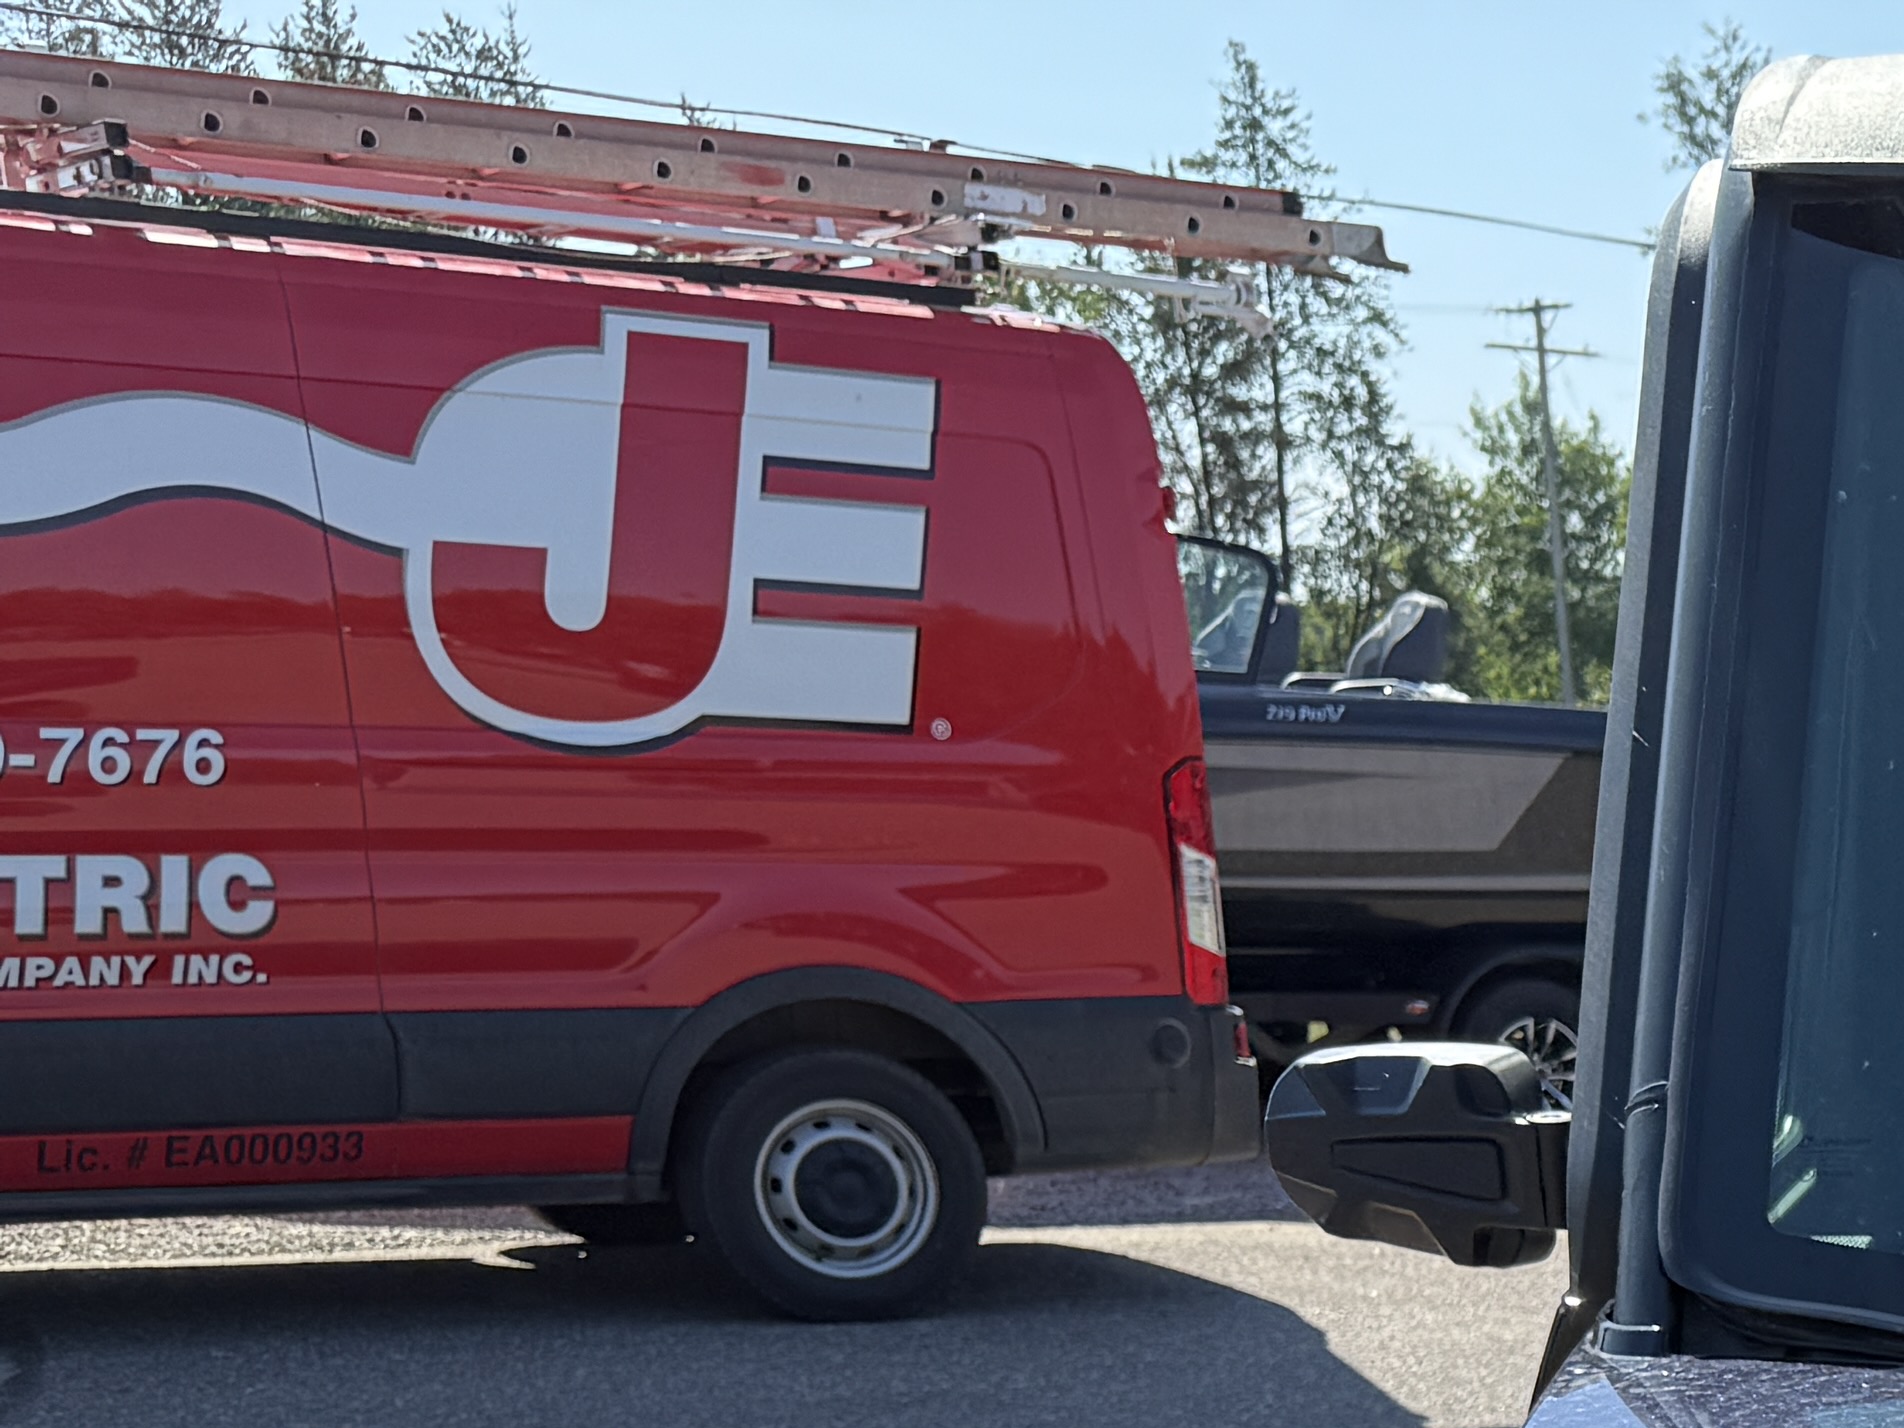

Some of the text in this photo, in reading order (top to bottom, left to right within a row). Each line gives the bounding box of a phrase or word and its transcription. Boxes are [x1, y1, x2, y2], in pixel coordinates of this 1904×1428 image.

[0, 727, 226, 786] -7676
[0, 852, 277, 938] TRIC
[171, 953, 268, 985] INC.
[36, 1130, 365, 1174] Lic. # EA000933
